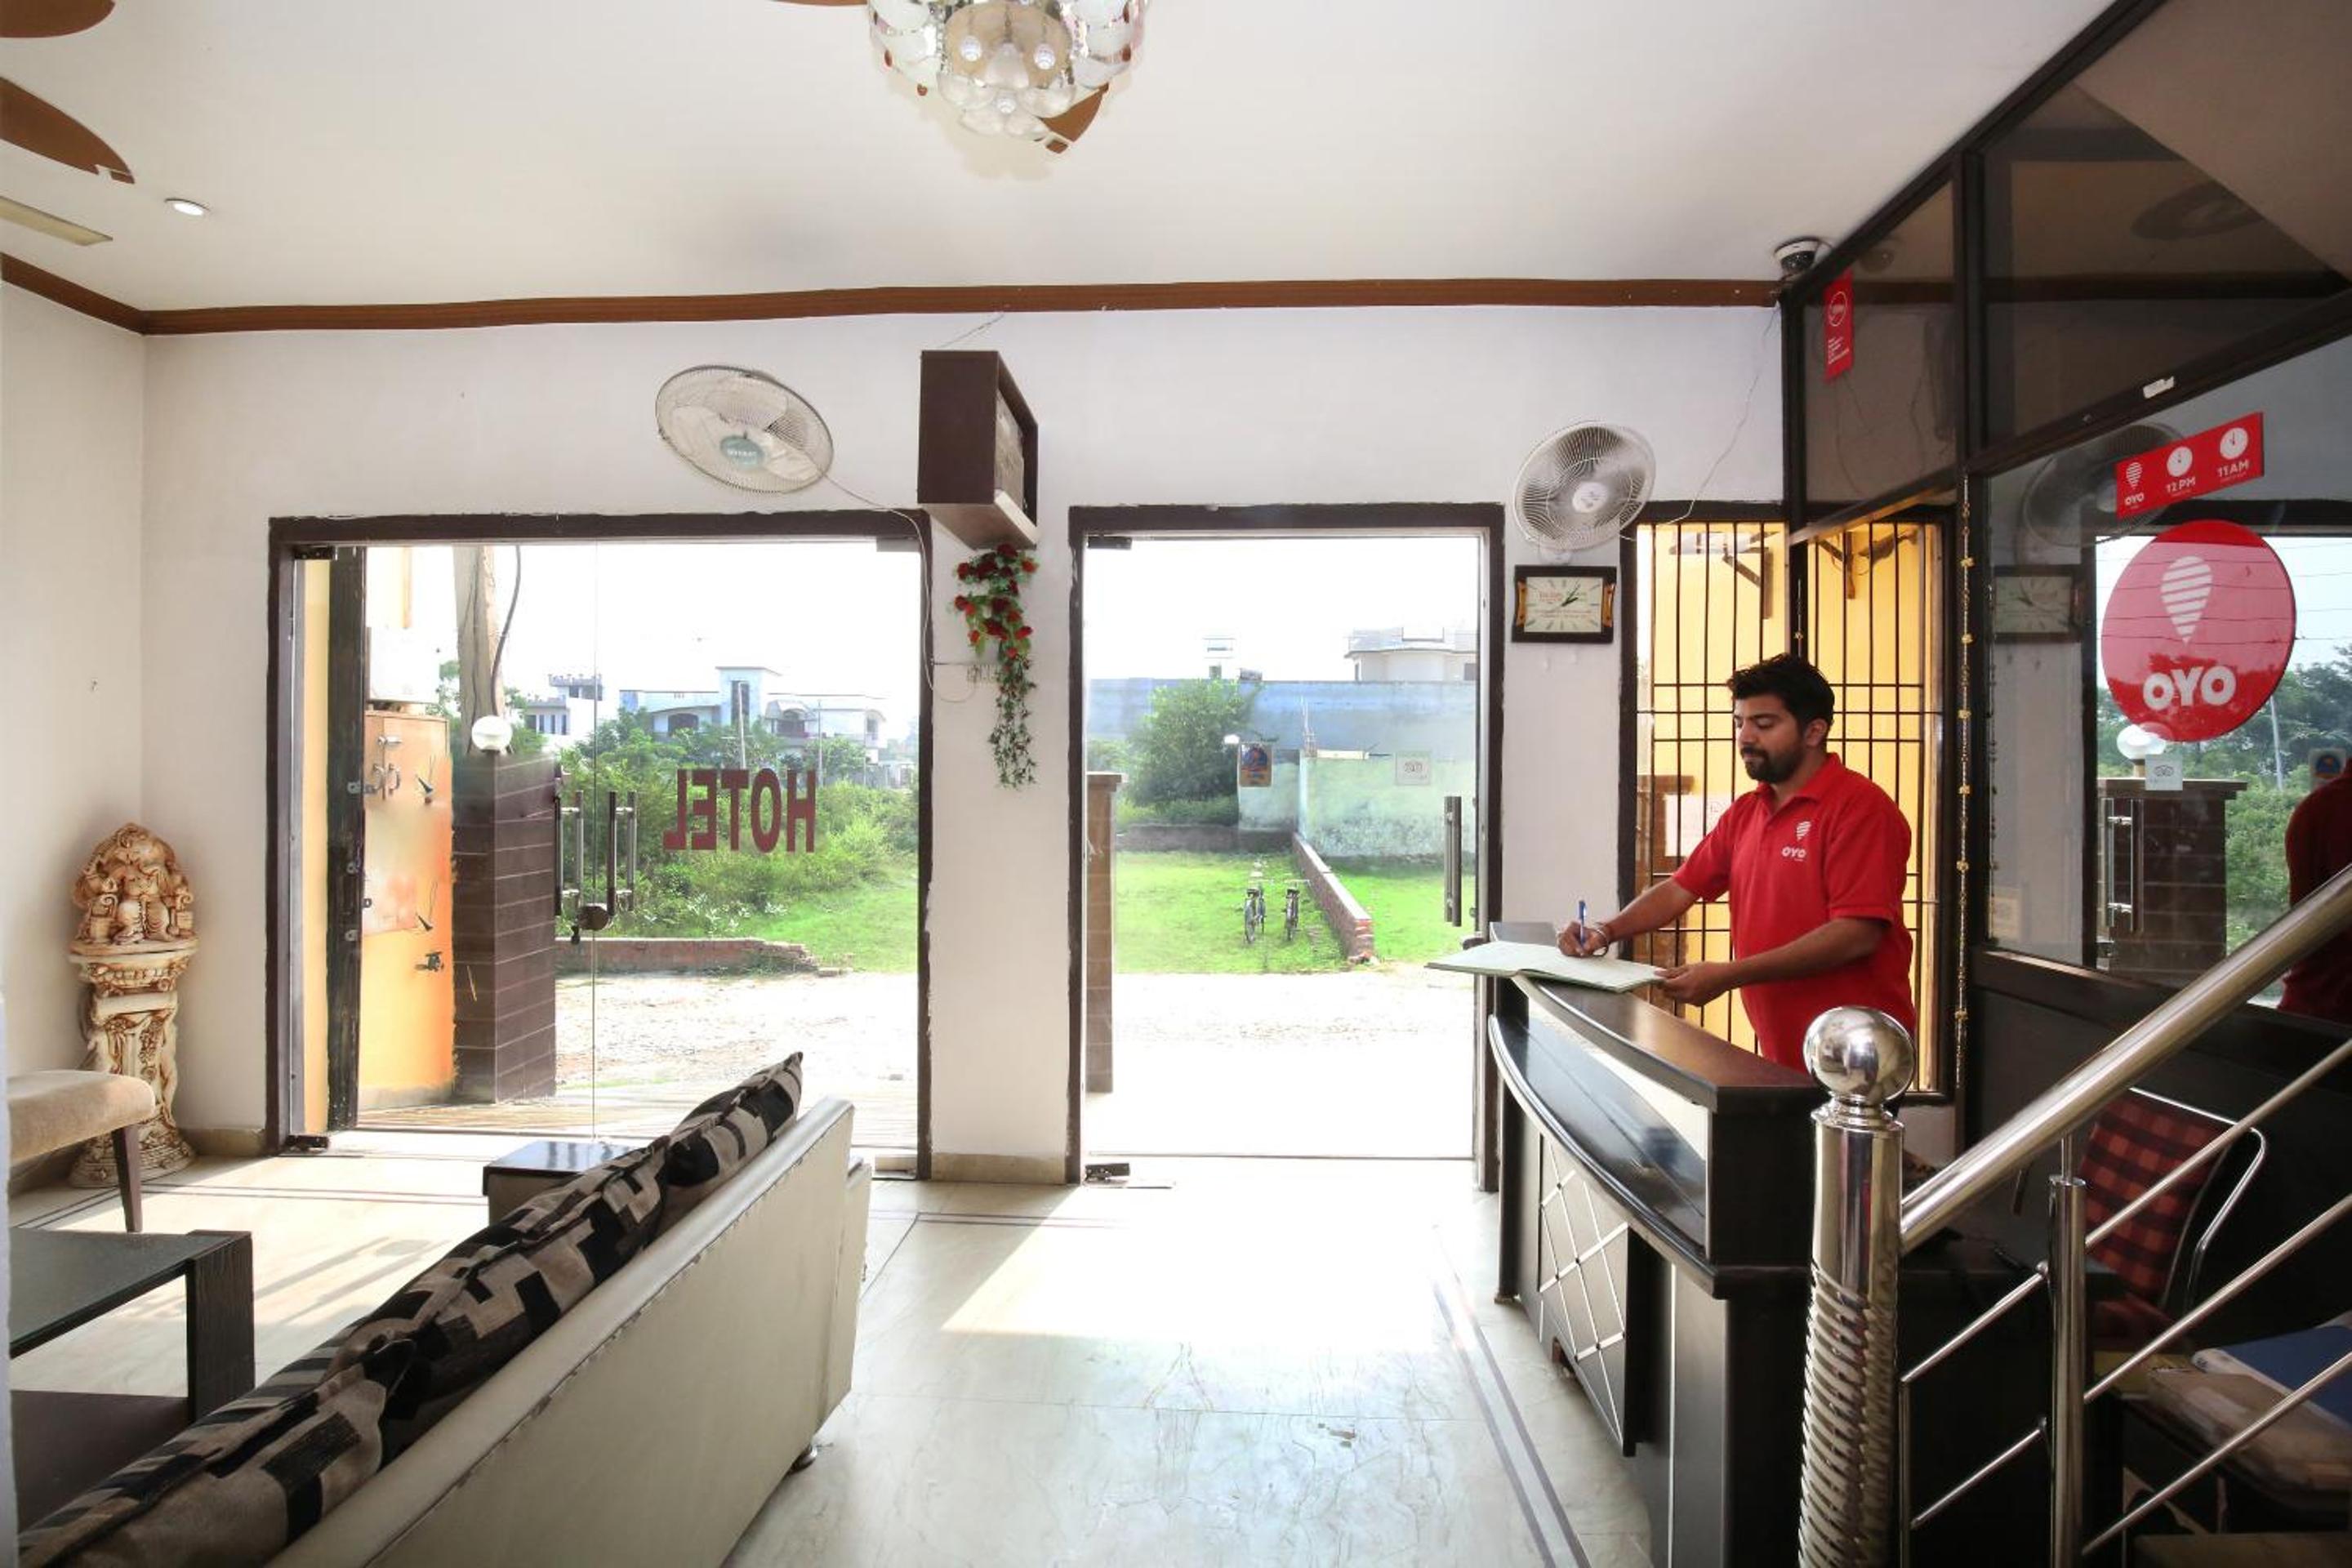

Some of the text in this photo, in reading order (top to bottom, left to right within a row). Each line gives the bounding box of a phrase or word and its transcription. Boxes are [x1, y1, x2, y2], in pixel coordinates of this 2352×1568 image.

[2230, 459, 2249, 474] AM
[2166, 476, 2196, 492] 12 PM
[2124, 492, 2145, 506] OYO
[2143, 666, 2237, 710] OYO
[1781, 846, 1807, 858] OYO
